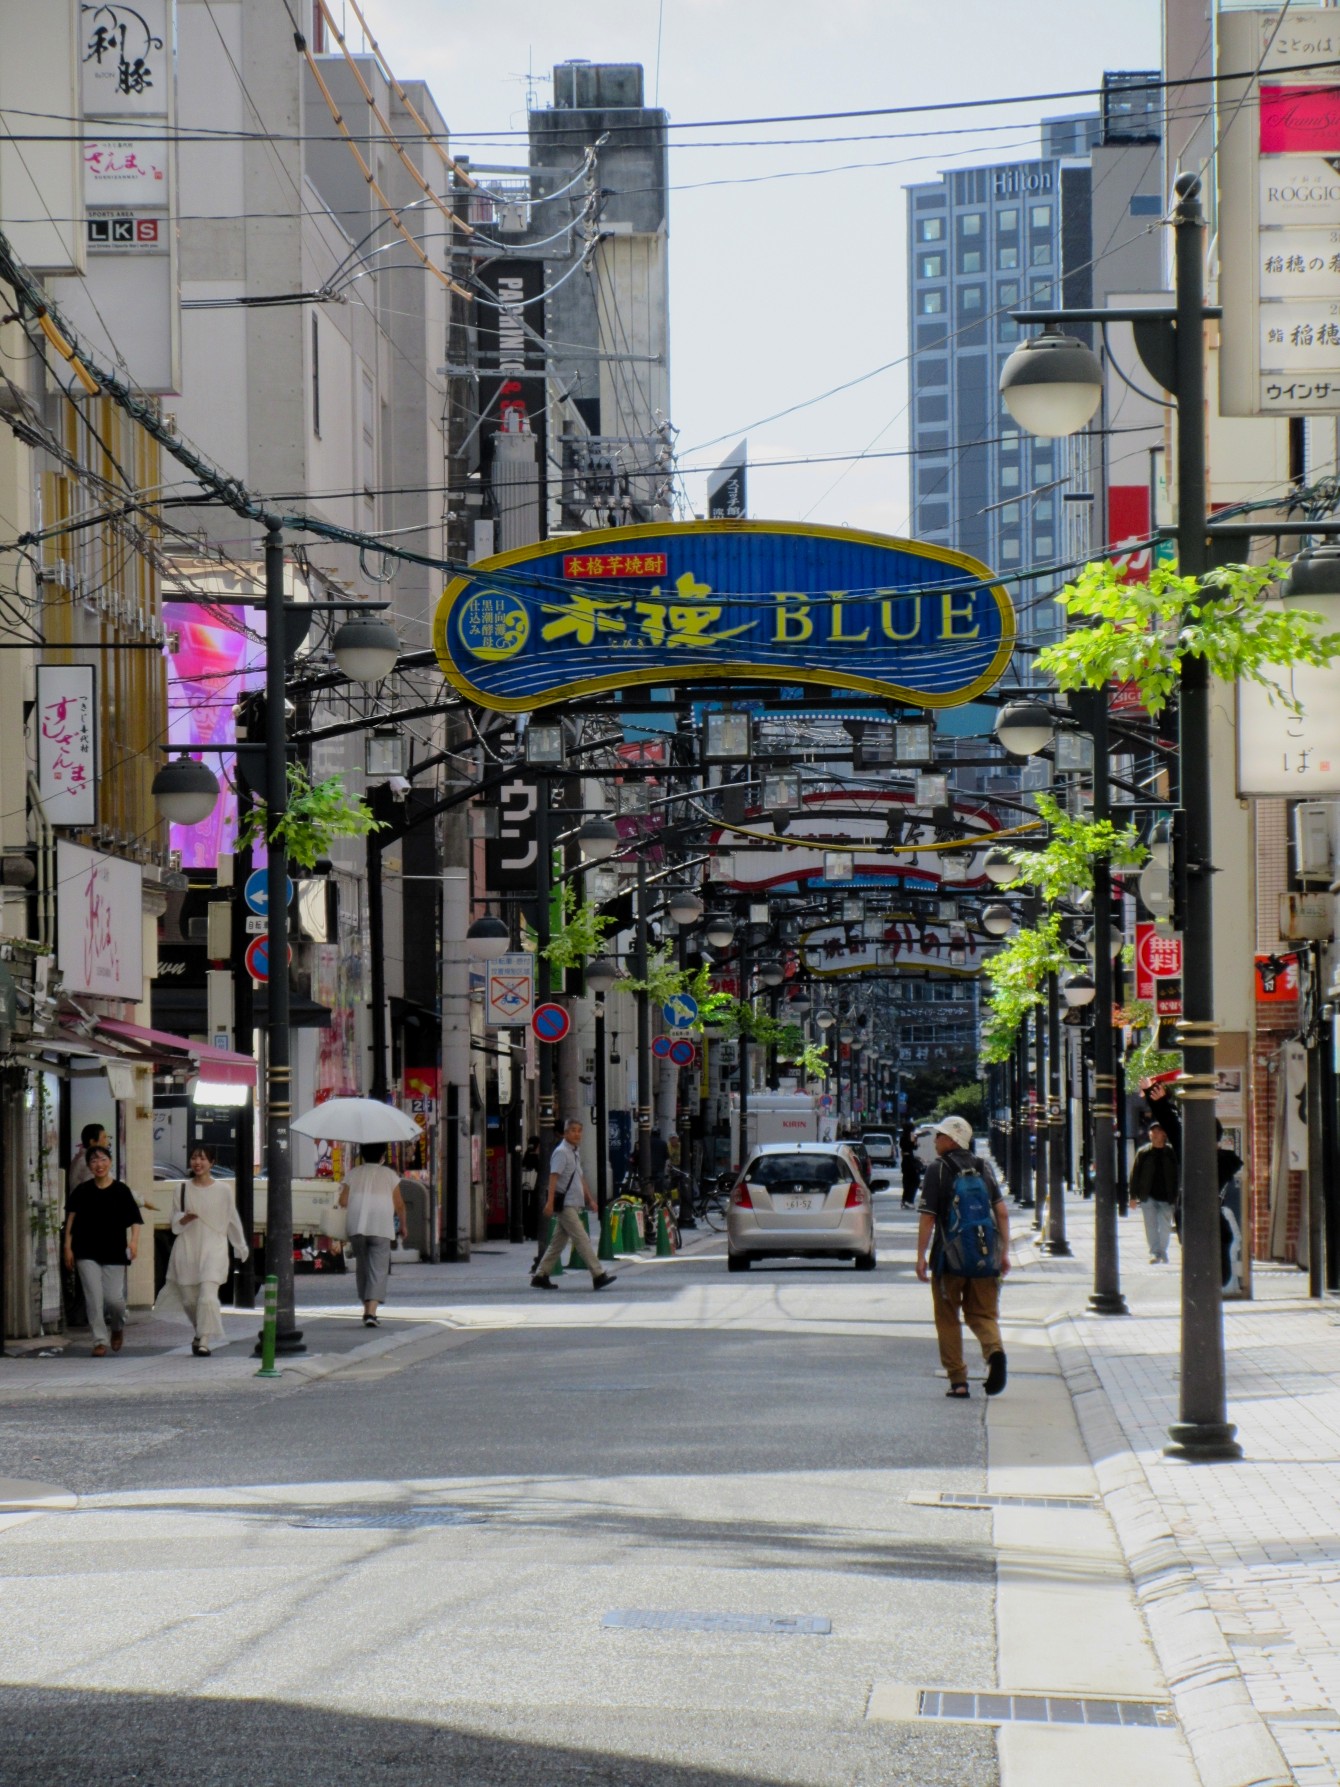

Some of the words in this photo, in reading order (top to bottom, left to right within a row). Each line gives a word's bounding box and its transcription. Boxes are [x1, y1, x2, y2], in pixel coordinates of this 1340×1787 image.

[994, 171, 1051, 193] Hilton
[1268, 328, 1284, 343] 鮨
[567, 555, 664, 577] 本格芋焼酎
[770, 589, 980, 642] BLUE
[1149, 936, 1178, 971] 無料
[783, 1120, 807, 1128] KIRIN
